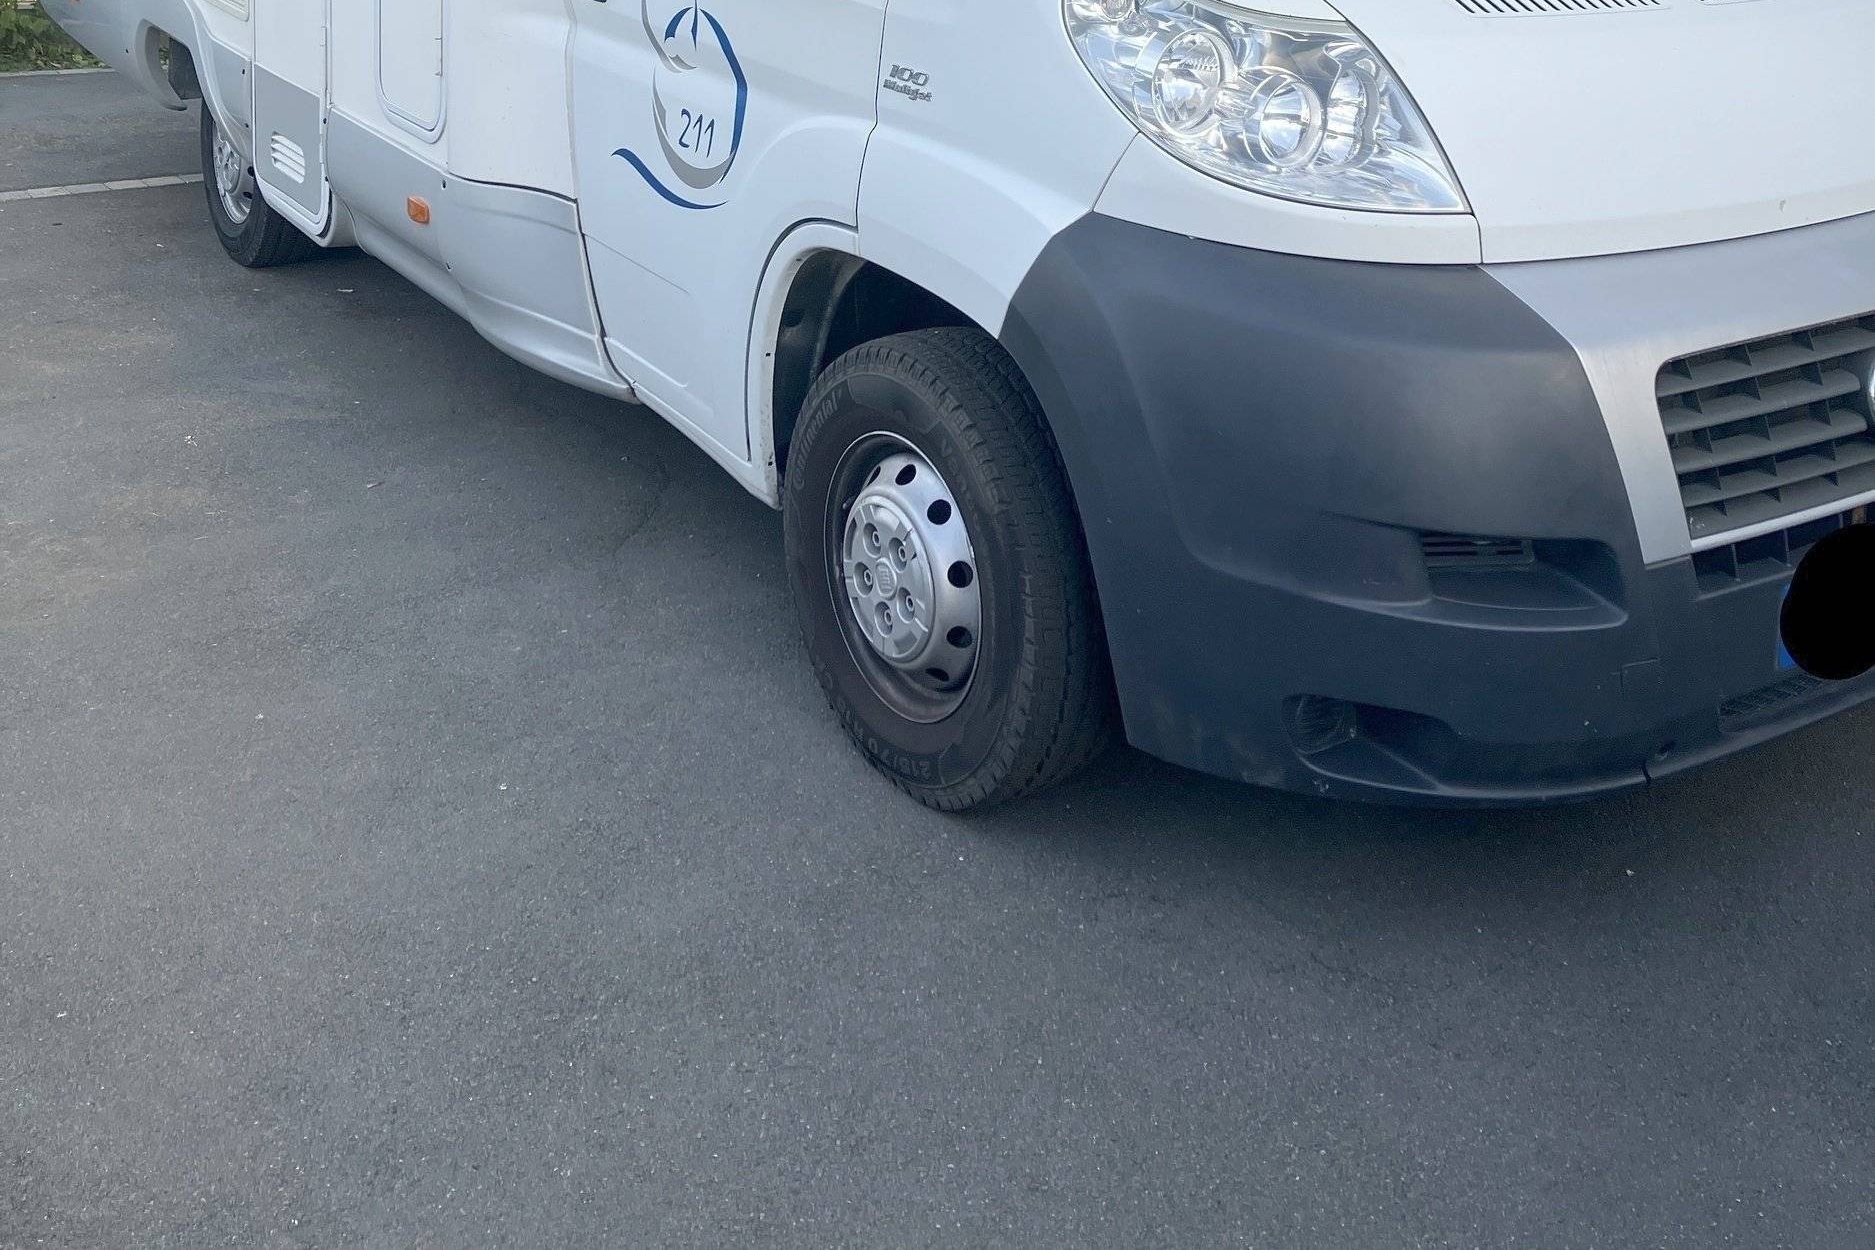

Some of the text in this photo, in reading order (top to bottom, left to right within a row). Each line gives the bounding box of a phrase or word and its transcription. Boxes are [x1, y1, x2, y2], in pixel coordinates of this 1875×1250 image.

[889, 64, 929, 86] 100
[678, 108, 715, 158] 211
[792, 388, 838, 490] Continental
